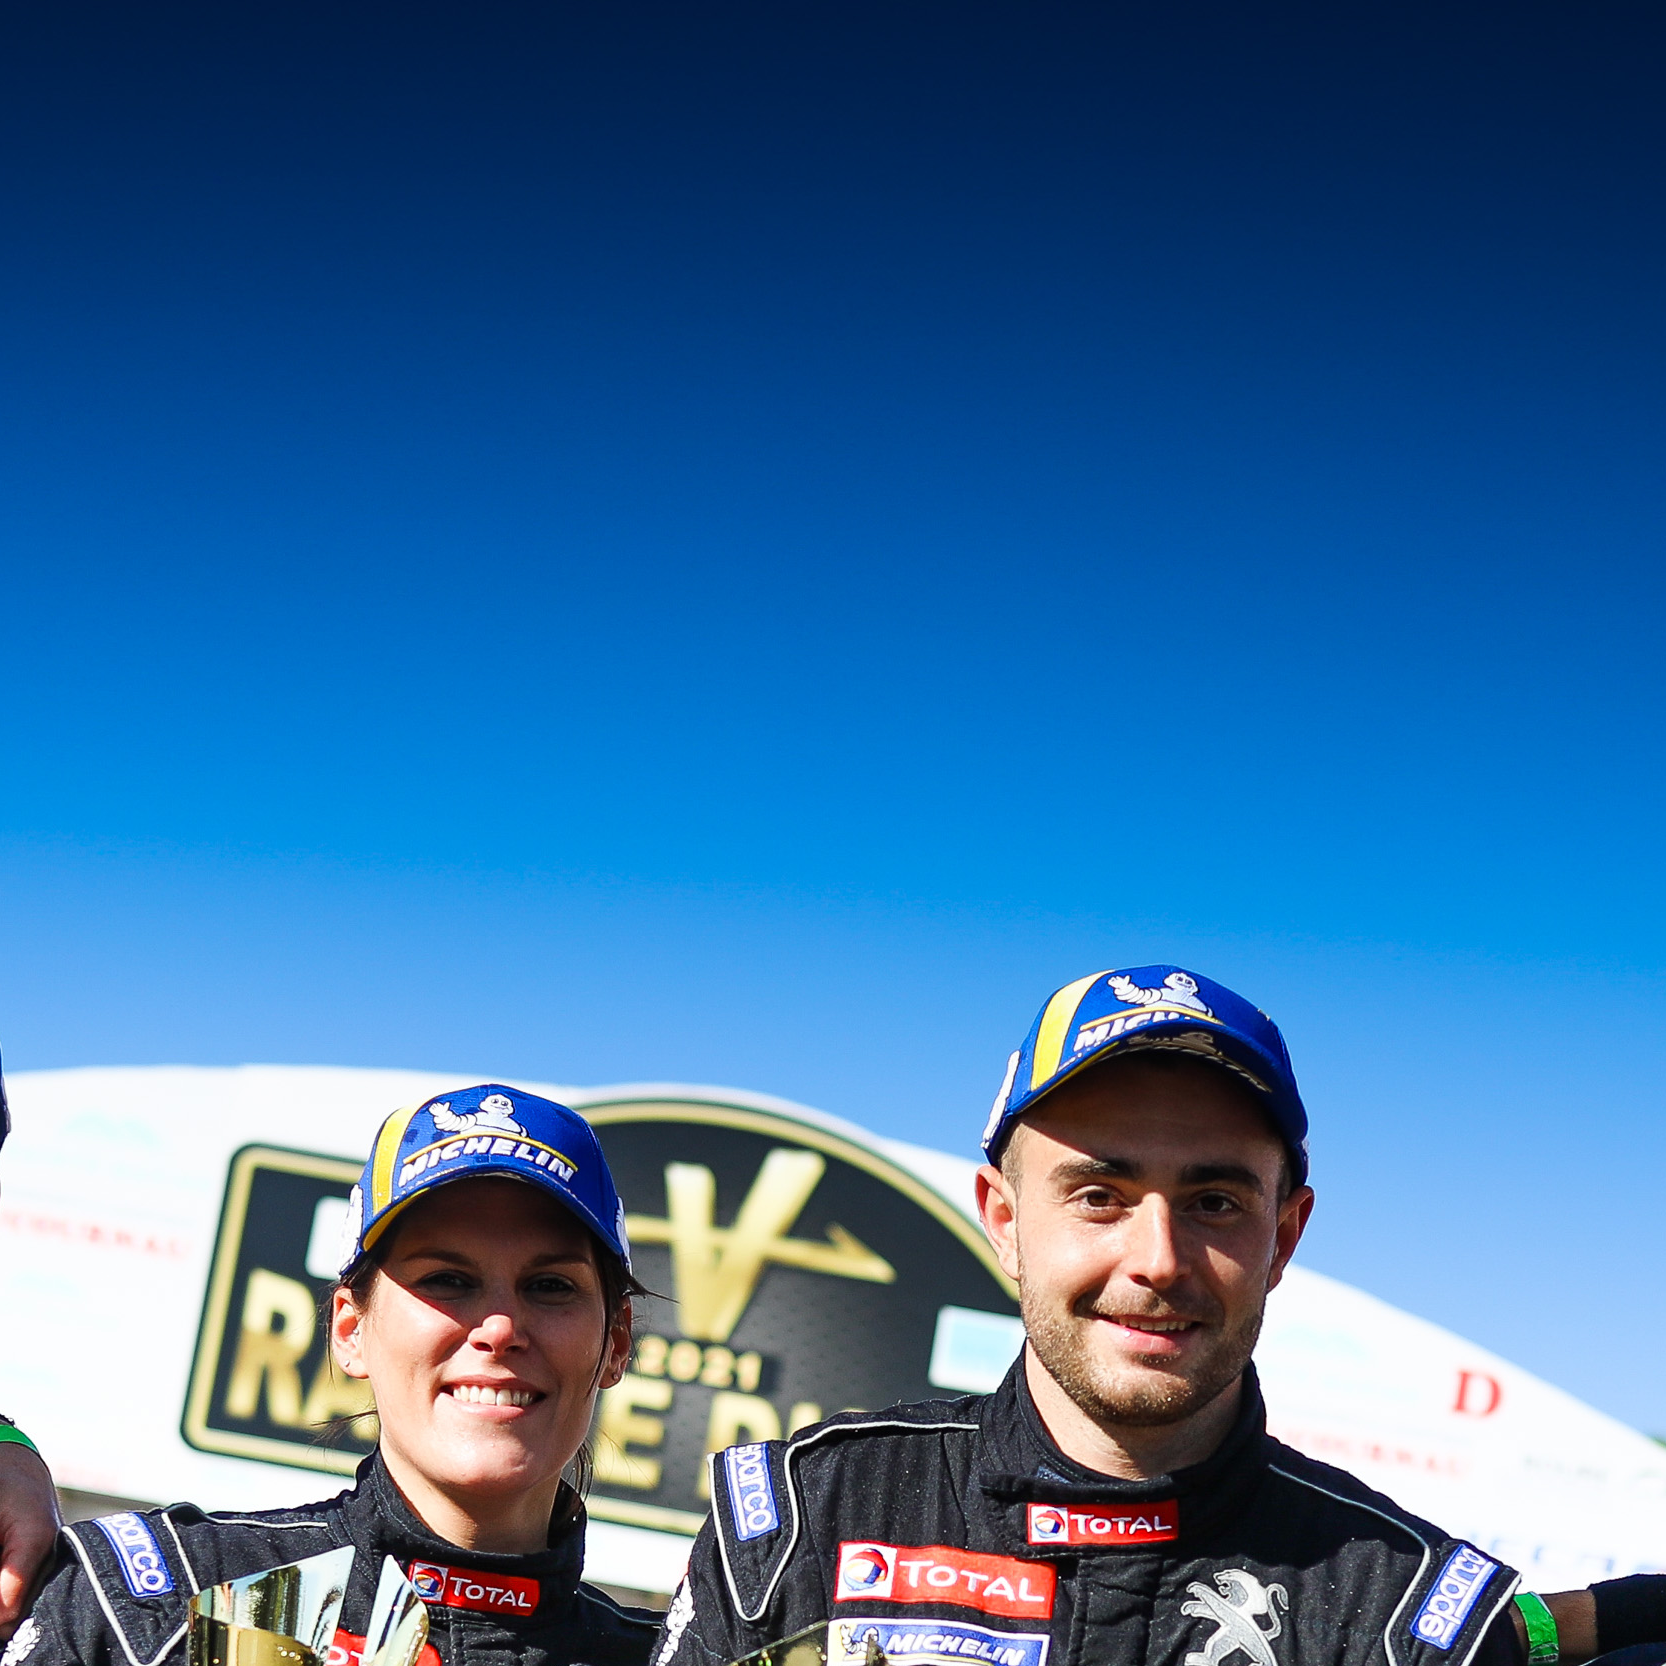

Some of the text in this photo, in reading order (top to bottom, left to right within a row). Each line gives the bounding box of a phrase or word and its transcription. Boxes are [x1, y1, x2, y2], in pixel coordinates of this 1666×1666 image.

[397, 1136, 575, 1187] MICHELIN
[633, 1333, 764, 1393] 2021
[1452, 1368, 1504, 1418] D
[727, 1443, 773, 1532] sparco
[1069, 1513, 1173, 1535] TOTAL
[448, 1576, 533, 1609] TOTAL
[898, 1560, 1045, 1603] TOTAL
[1417, 1547, 1485, 1642] sparco
[885, 1633, 1026, 1666] MICHELIN
